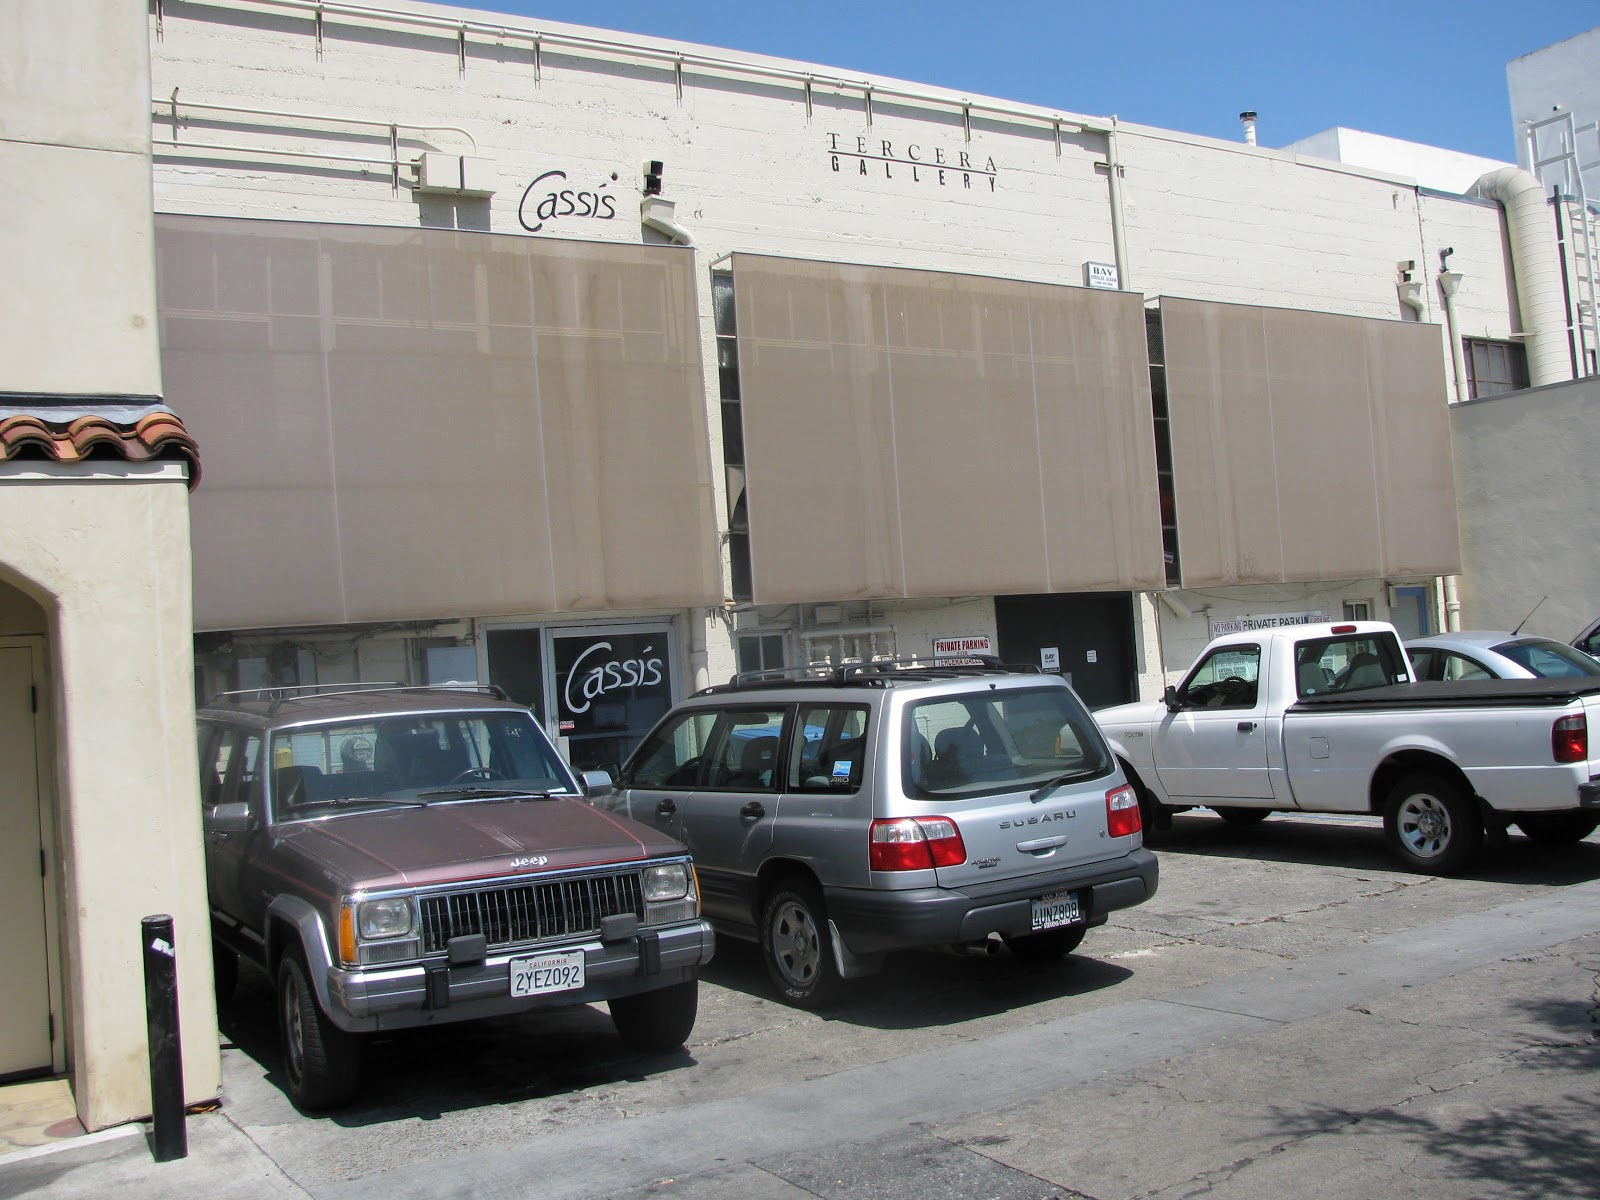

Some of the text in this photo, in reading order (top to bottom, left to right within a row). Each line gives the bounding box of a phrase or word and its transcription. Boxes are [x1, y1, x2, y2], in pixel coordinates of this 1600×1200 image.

[827, 132, 997, 172] TERCERA
[831, 154, 995, 192] GALLERY
[1093, 266, 1113, 276] BAY
[1221, 620, 1242, 632] PARKING
[1243, 618, 1277, 630] PRIVATE
[1279, 616, 1310, 626] PARKIN
[936, 638, 989, 652] PRIVATE PARKING
[999, 810, 1076, 829] SUBARU
[510, 855, 548, 868] Jeep
[1034, 902, 1077, 924] 4UNZ808
[529, 957, 567, 968] CALIFORNIA
[516, 966, 580, 992] 2YEZ092
